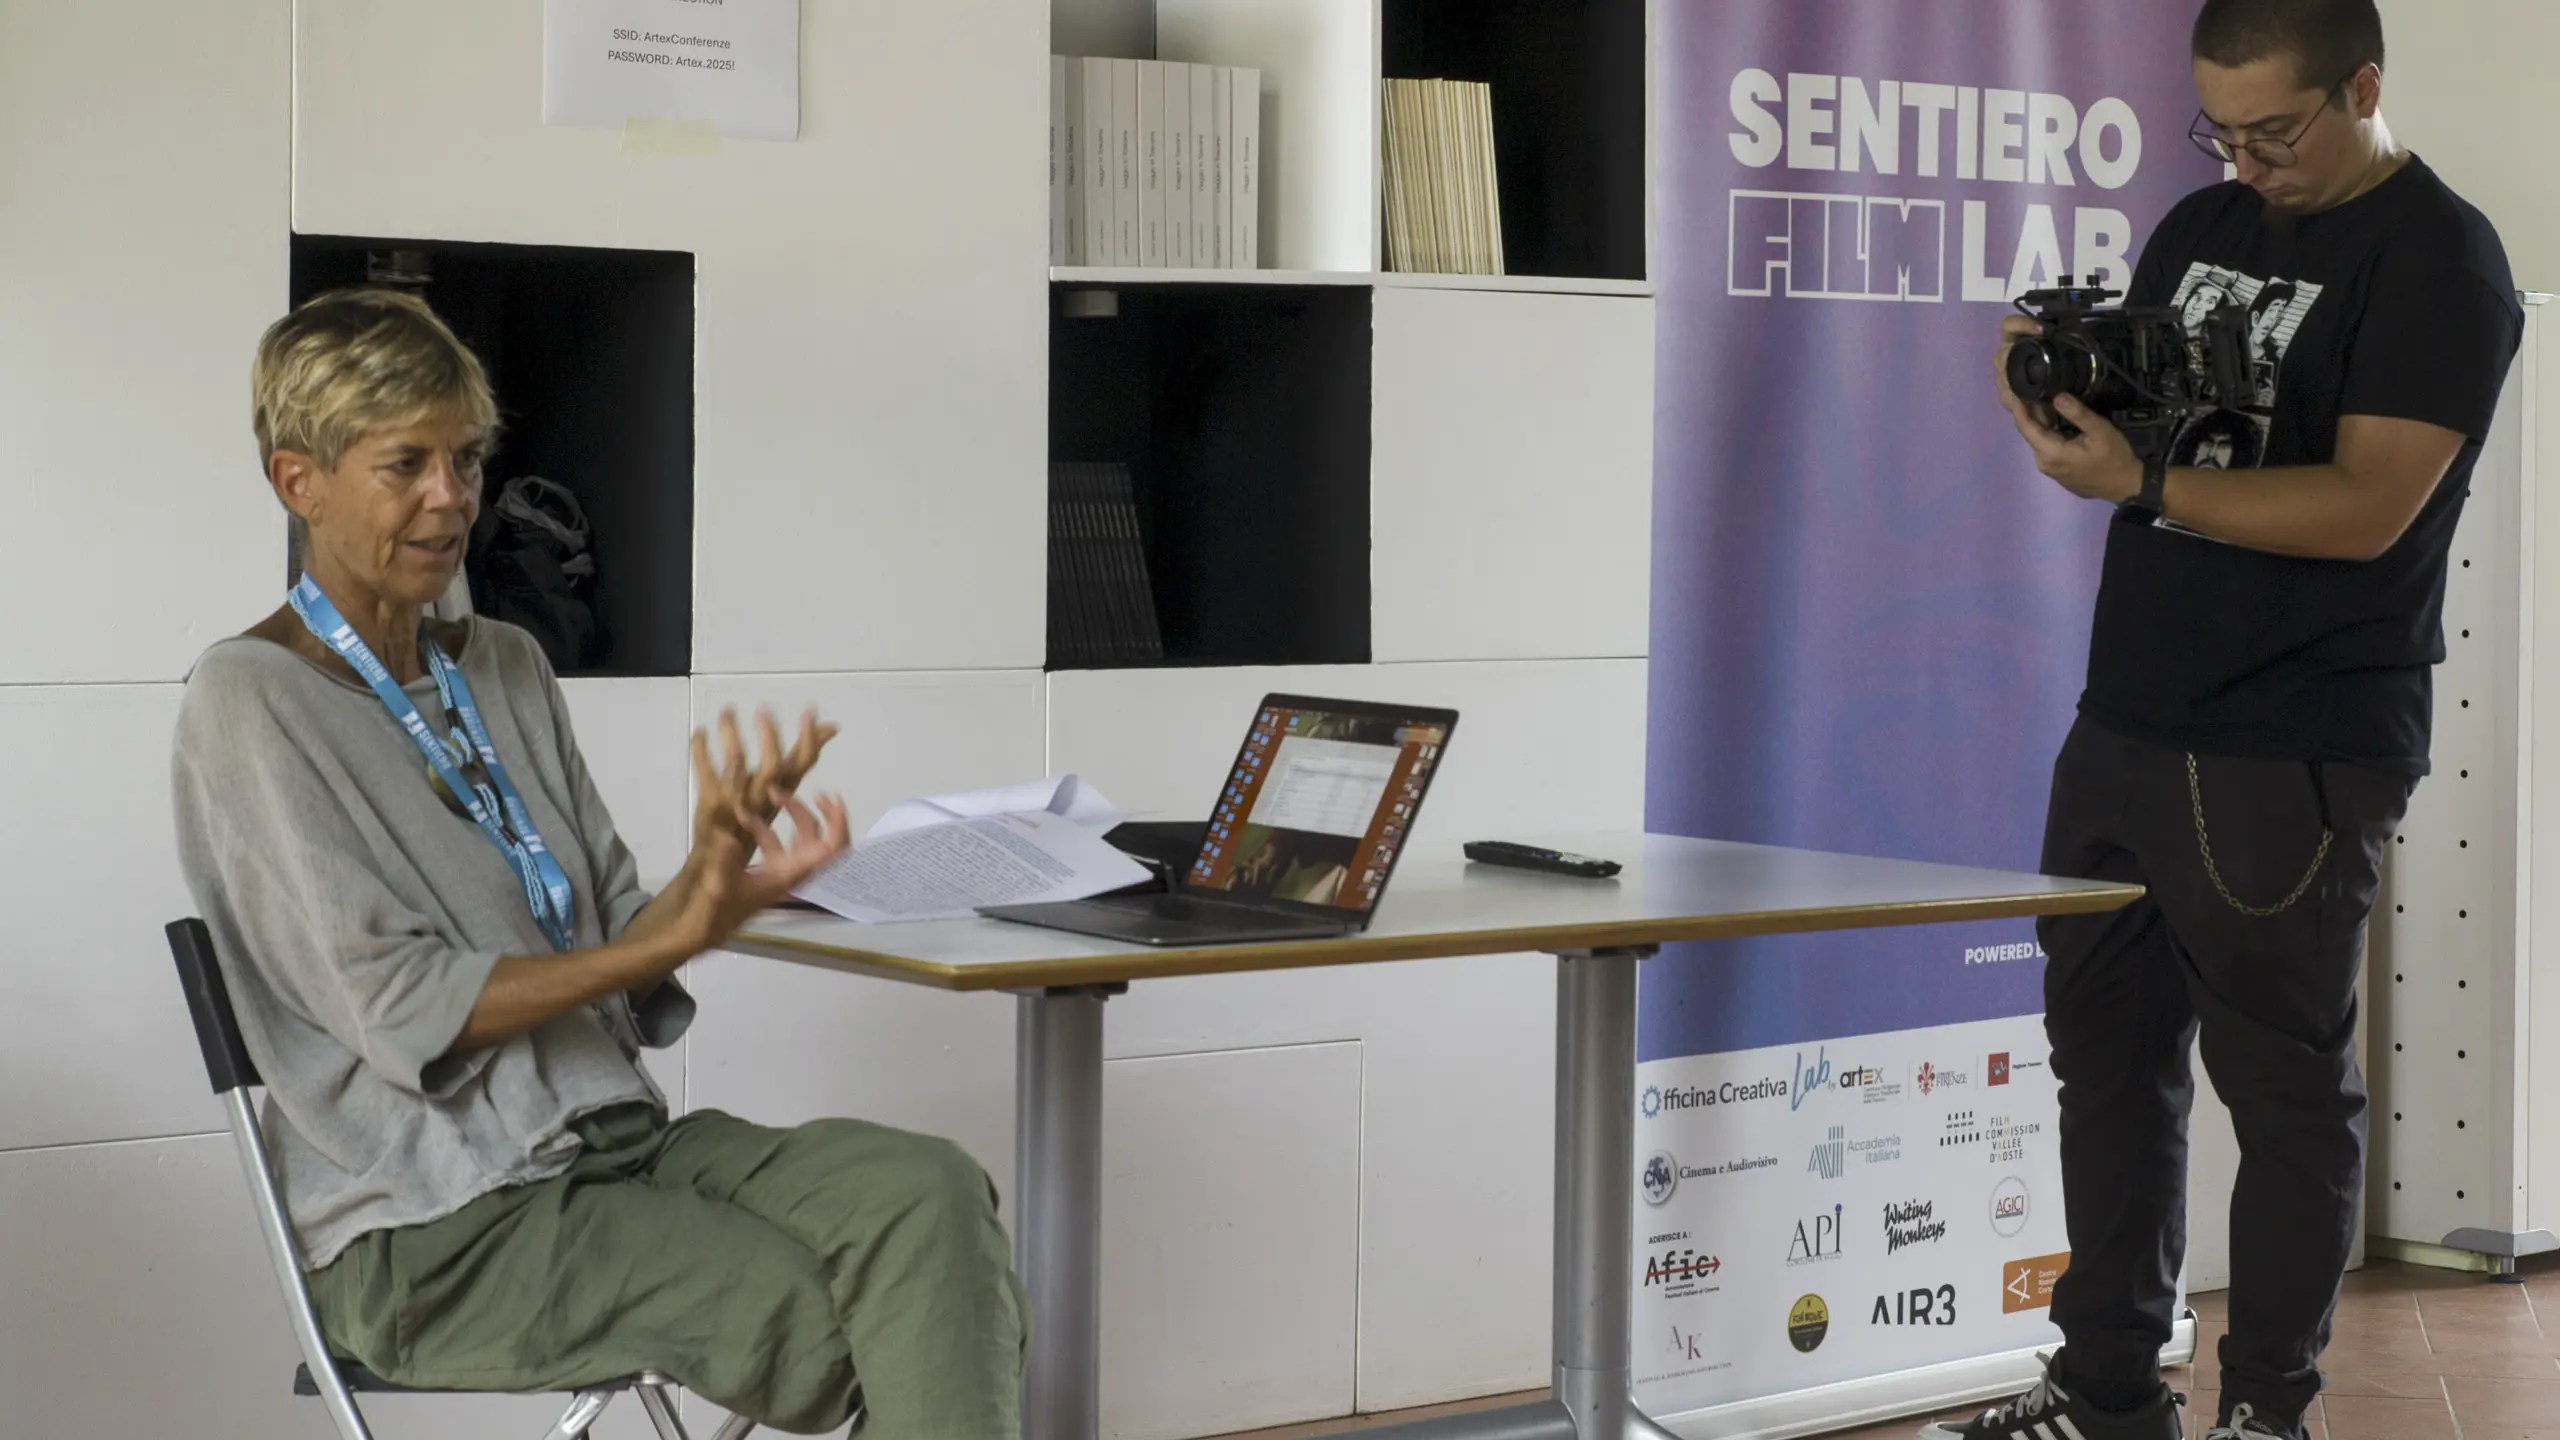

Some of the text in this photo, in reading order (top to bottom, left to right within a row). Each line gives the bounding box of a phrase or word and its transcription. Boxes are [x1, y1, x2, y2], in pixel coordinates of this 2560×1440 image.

[612, 28, 731, 49] SSID: ArtexConferenze
[608, 50, 737, 71] PASSWORD: Artex.2025!
[1728, 68, 2142, 190] SENTIERO
[1728, 188, 2133, 306] FILM LAB
[1965, 942, 2034, 965] POWERED
[1719, 1077, 1787, 1104] Creativa
[1791, 1046, 1831, 1111] Lab
[1986, 1123, 2040, 1140] COMMISSION
[1990, 1115, 2010, 1127] FILM
[1848, 1133, 1901, 1152] Accademia
[1680, 1155, 1778, 1180] Cinema e Audiovisivo
[1866, 1149, 1901, 1165] Italiana
[1883, 1199, 1932, 1230] Writing
[1996, 1195, 2024, 1215] AGICI
[1648, 1232, 1682, 1244] ADERISCE
[1886, 1220, 1945, 1255] Monkeys
[1644, 1250, 1709, 1287] Afic
